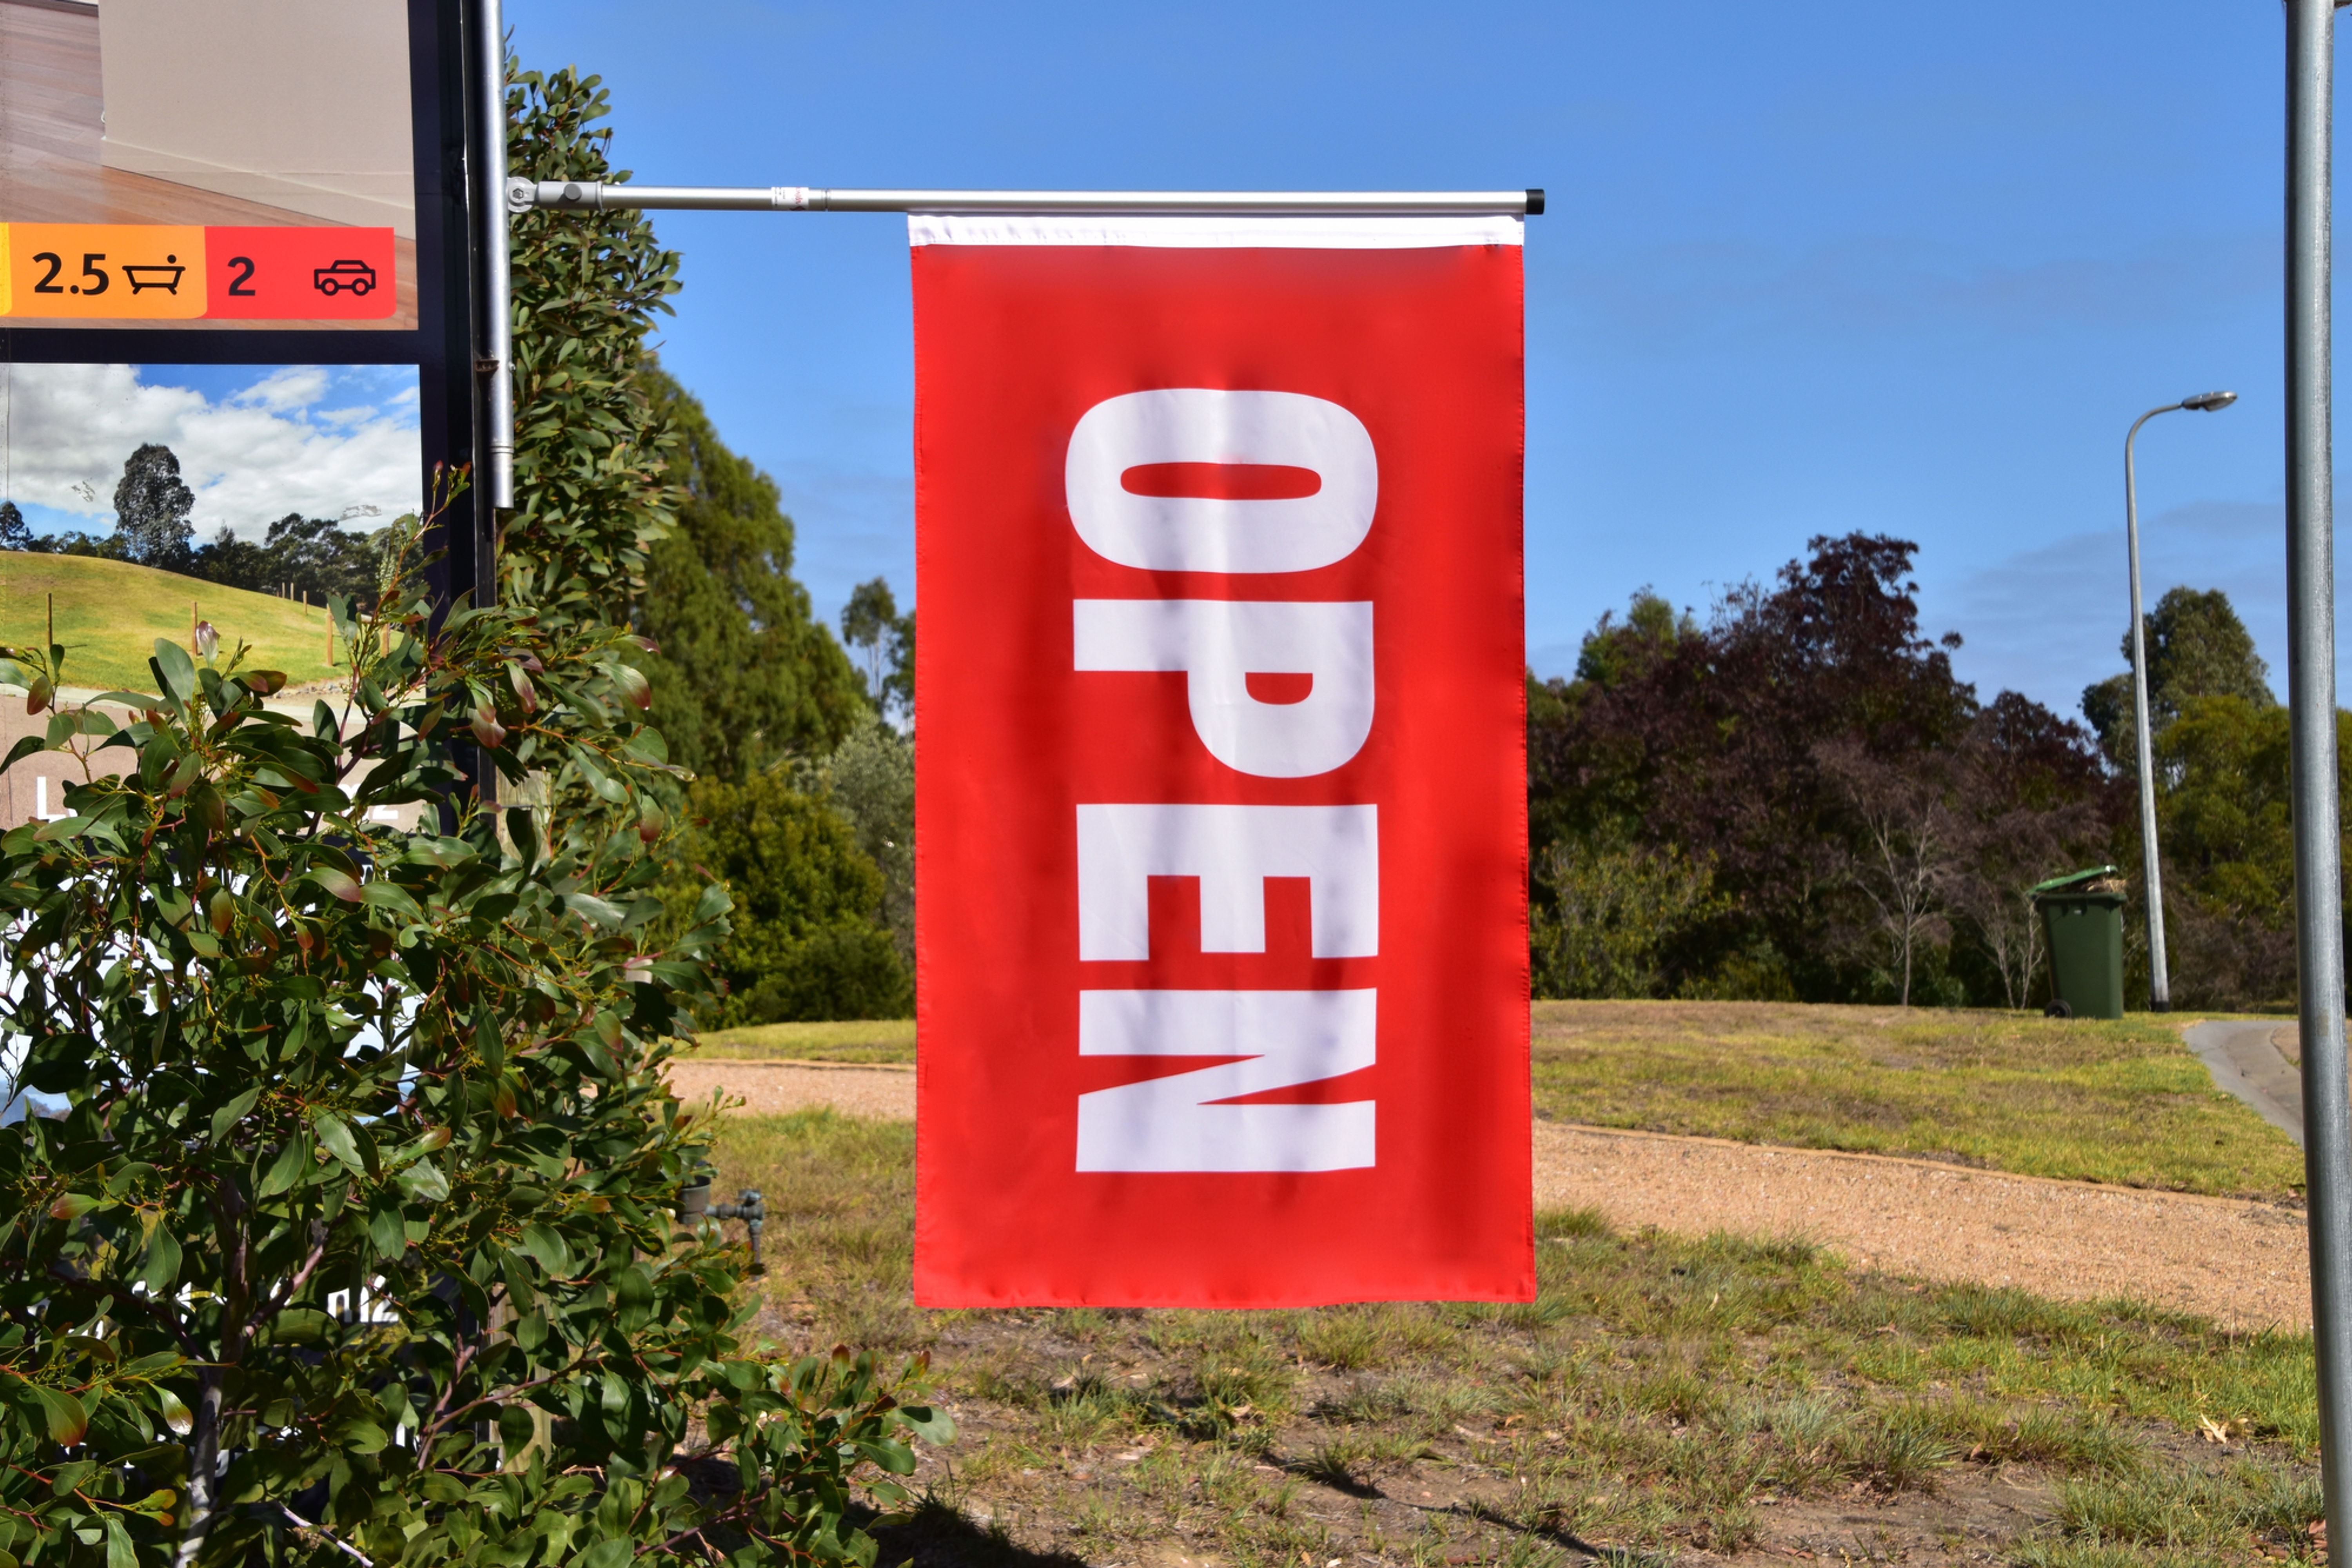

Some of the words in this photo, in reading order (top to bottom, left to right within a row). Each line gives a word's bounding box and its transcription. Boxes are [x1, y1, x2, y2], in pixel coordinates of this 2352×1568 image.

[33, 252, 109, 295] 2.5
[228, 256, 255, 296] 2
[1065, 388, 1379, 1172] OPEN
